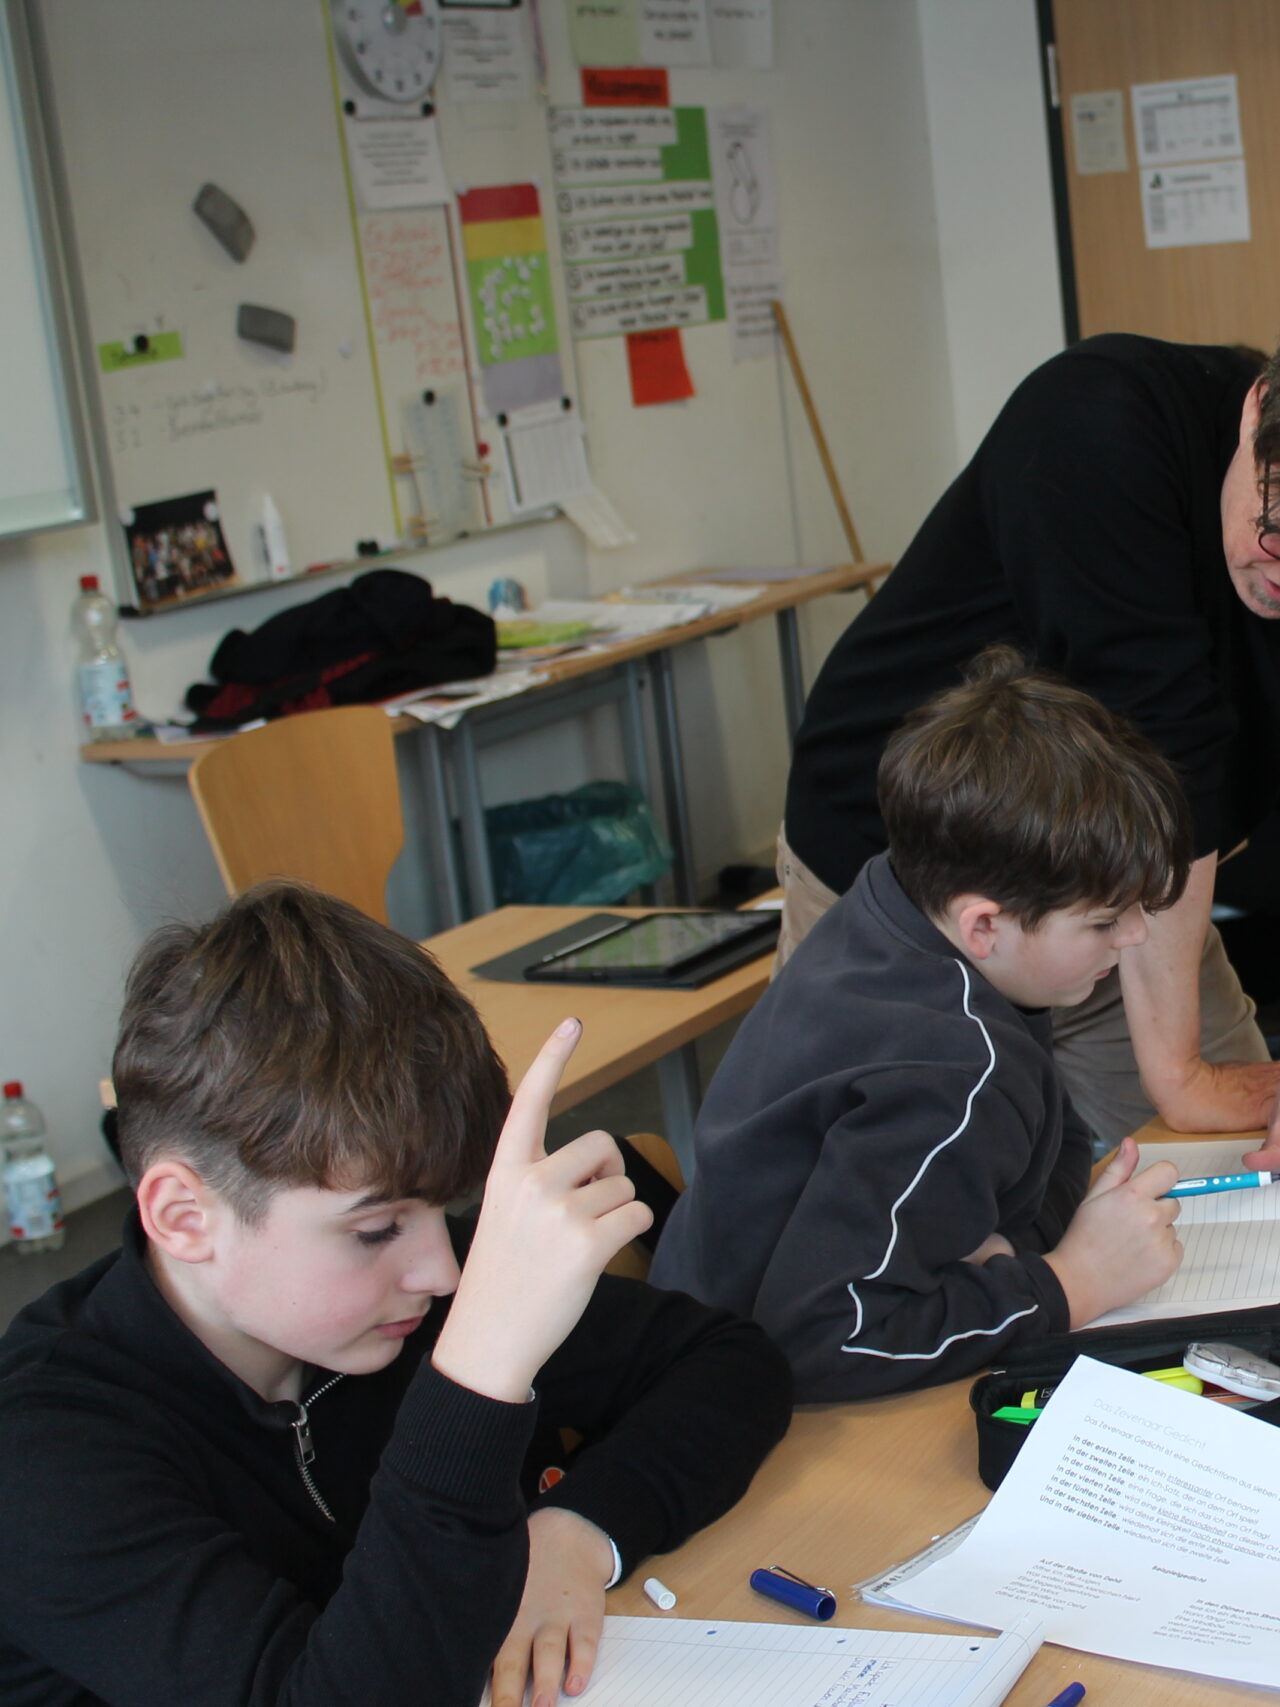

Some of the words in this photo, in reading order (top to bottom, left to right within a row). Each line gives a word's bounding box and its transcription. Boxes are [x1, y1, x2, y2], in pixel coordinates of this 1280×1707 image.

[1070, 1459, 1083, 1467] der
[1084, 1465, 1107, 1478] dritten
[1076, 1449, 1088, 1457] der
[1089, 1455, 1117, 1470] zweiten
[1082, 1439, 1094, 1447] der
[1095, 1445, 1117, 1457] ersten
[1139, 1461, 1155, 1473] wird
[1155, 1470, 1166, 1478] ein
[1059, 1479, 1072, 1488] der
[1073, 1483, 1098, 1499] fünften
[1065, 1469, 1077, 1478] der
[1079, 1475, 1103, 1488] vierten
[1040, 1495, 1055, 1505] Und
[1063, 1505, 1076, 1513] der
[1076, 1511, 1102, 1524] siebten
[1054, 1489, 1066, 1497] der
[1067, 1495, 1099, 1511] sechsten
